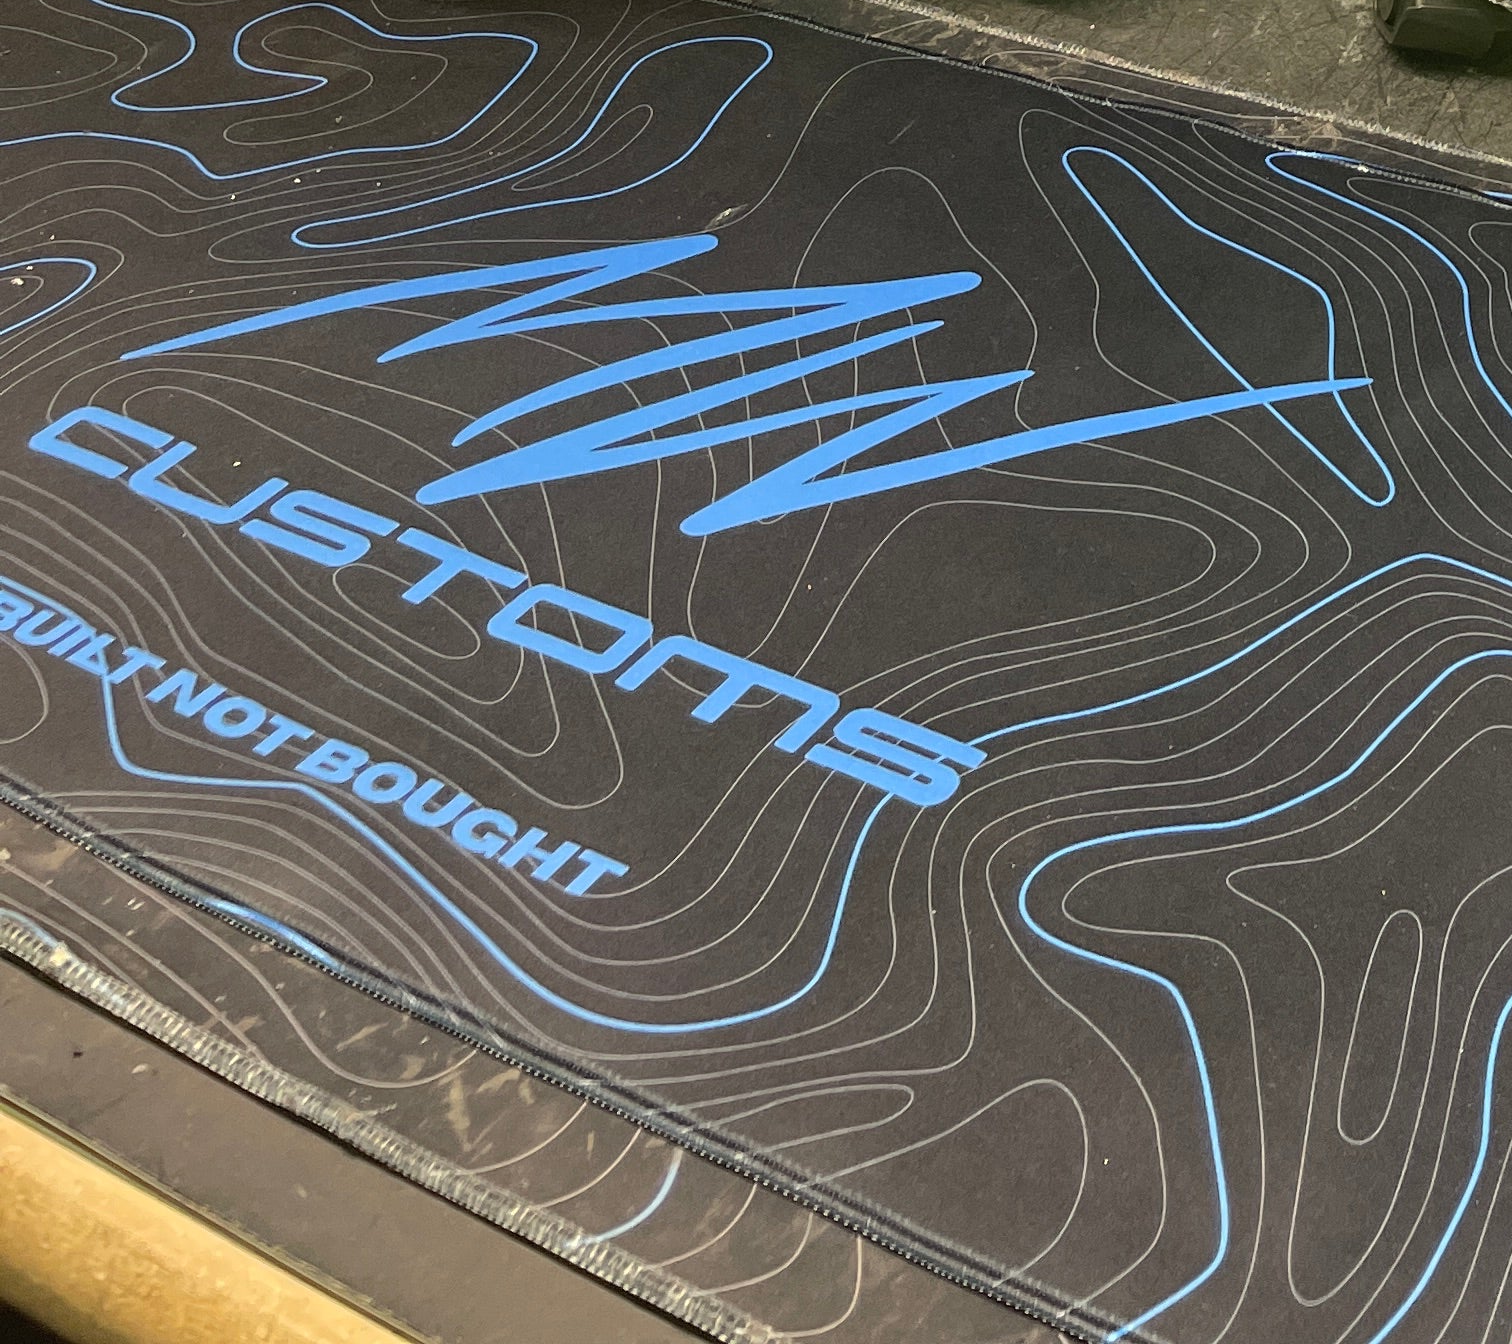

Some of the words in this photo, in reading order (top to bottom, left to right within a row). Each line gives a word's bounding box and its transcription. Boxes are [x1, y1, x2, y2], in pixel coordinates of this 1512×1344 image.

[27, 405, 988, 809] CUSTOMS
[145, 667, 317, 757] NOT
[295, 736, 631, 898] BOUGHT
